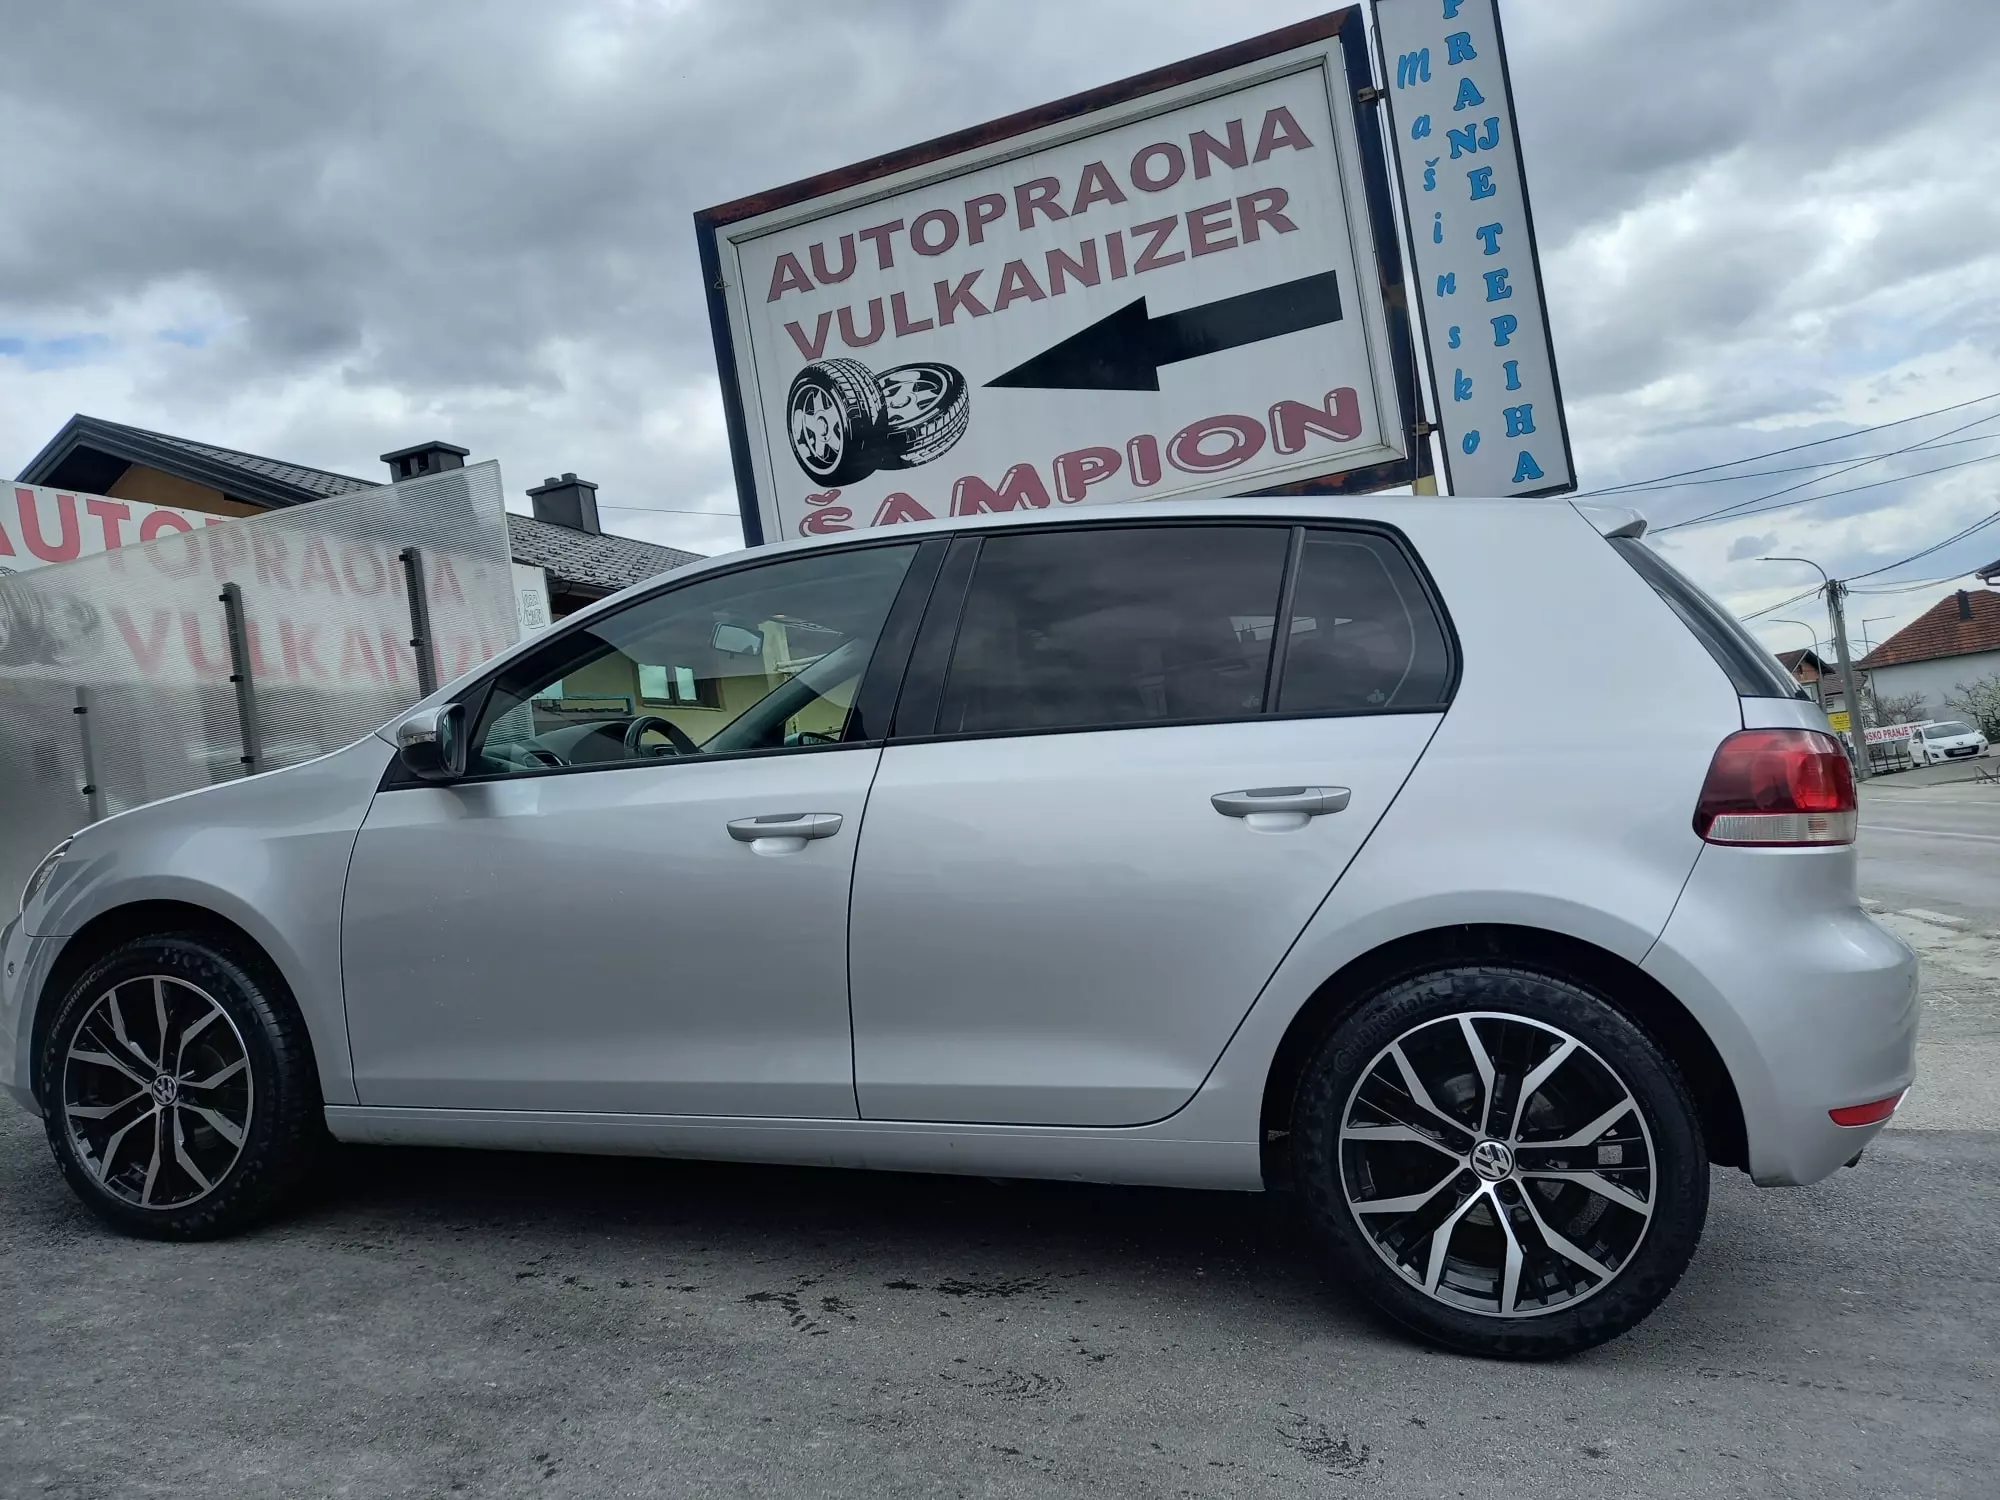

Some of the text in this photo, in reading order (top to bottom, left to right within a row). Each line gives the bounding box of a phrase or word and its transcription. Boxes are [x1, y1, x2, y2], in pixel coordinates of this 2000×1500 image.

[767, 105, 1314, 304] AUTOPRAONA
[784, 187, 1300, 361] VULKANIZER
[799, 387, 1363, 537] ŠAMPION
[0, 487, 467, 605] UTOPRAOA
[1883, 726, 1910, 738] PRANJE
